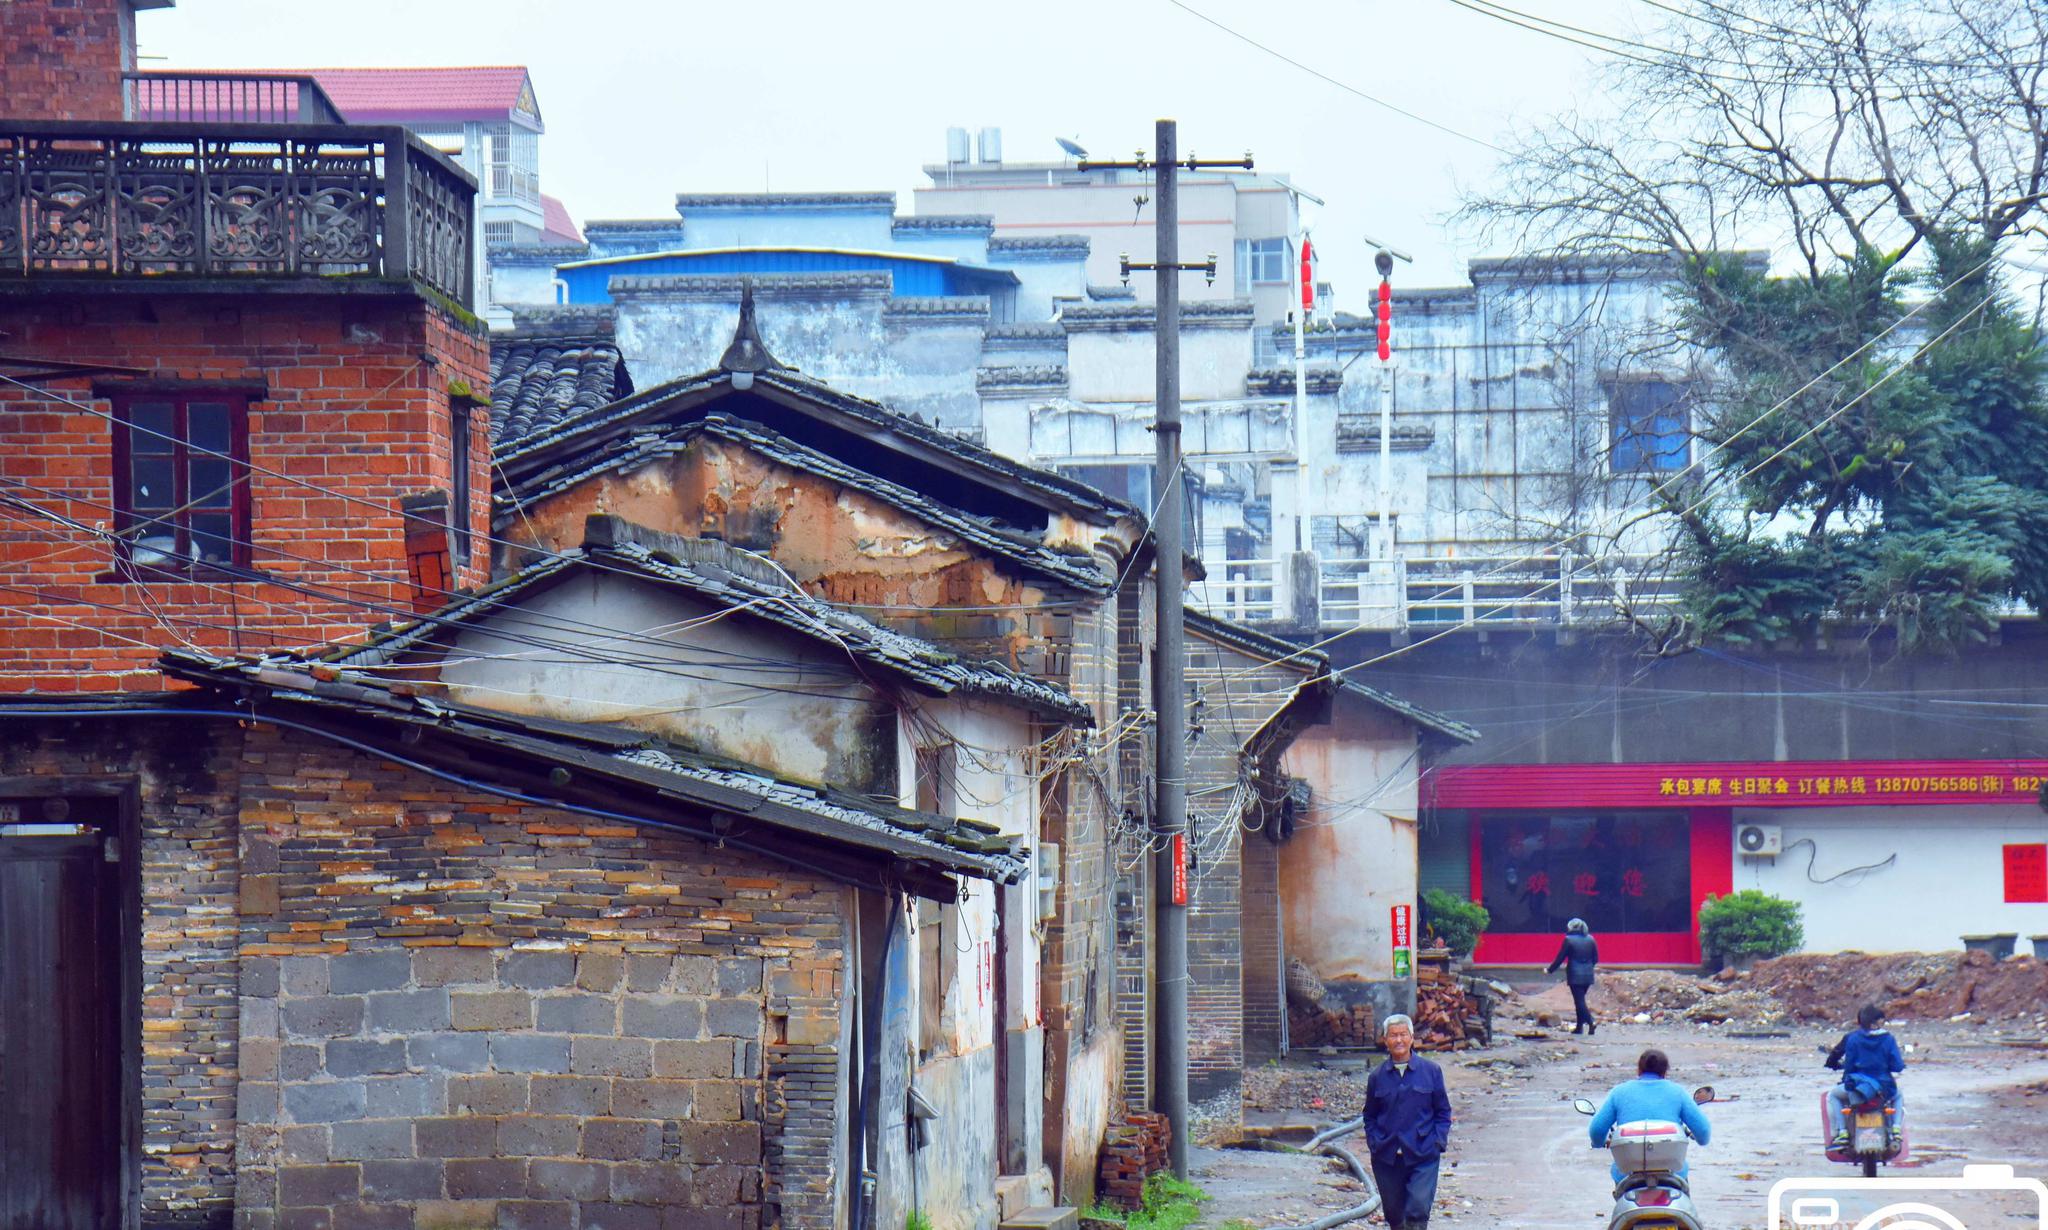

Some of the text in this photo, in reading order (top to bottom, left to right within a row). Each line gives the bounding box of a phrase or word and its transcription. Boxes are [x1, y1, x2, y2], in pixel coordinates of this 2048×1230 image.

[1660, 777, 1722, 795] 承包宴席
[1729, 777, 1789, 795] 生日聚会
[1799, 776, 1867, 795] 订餐热线
